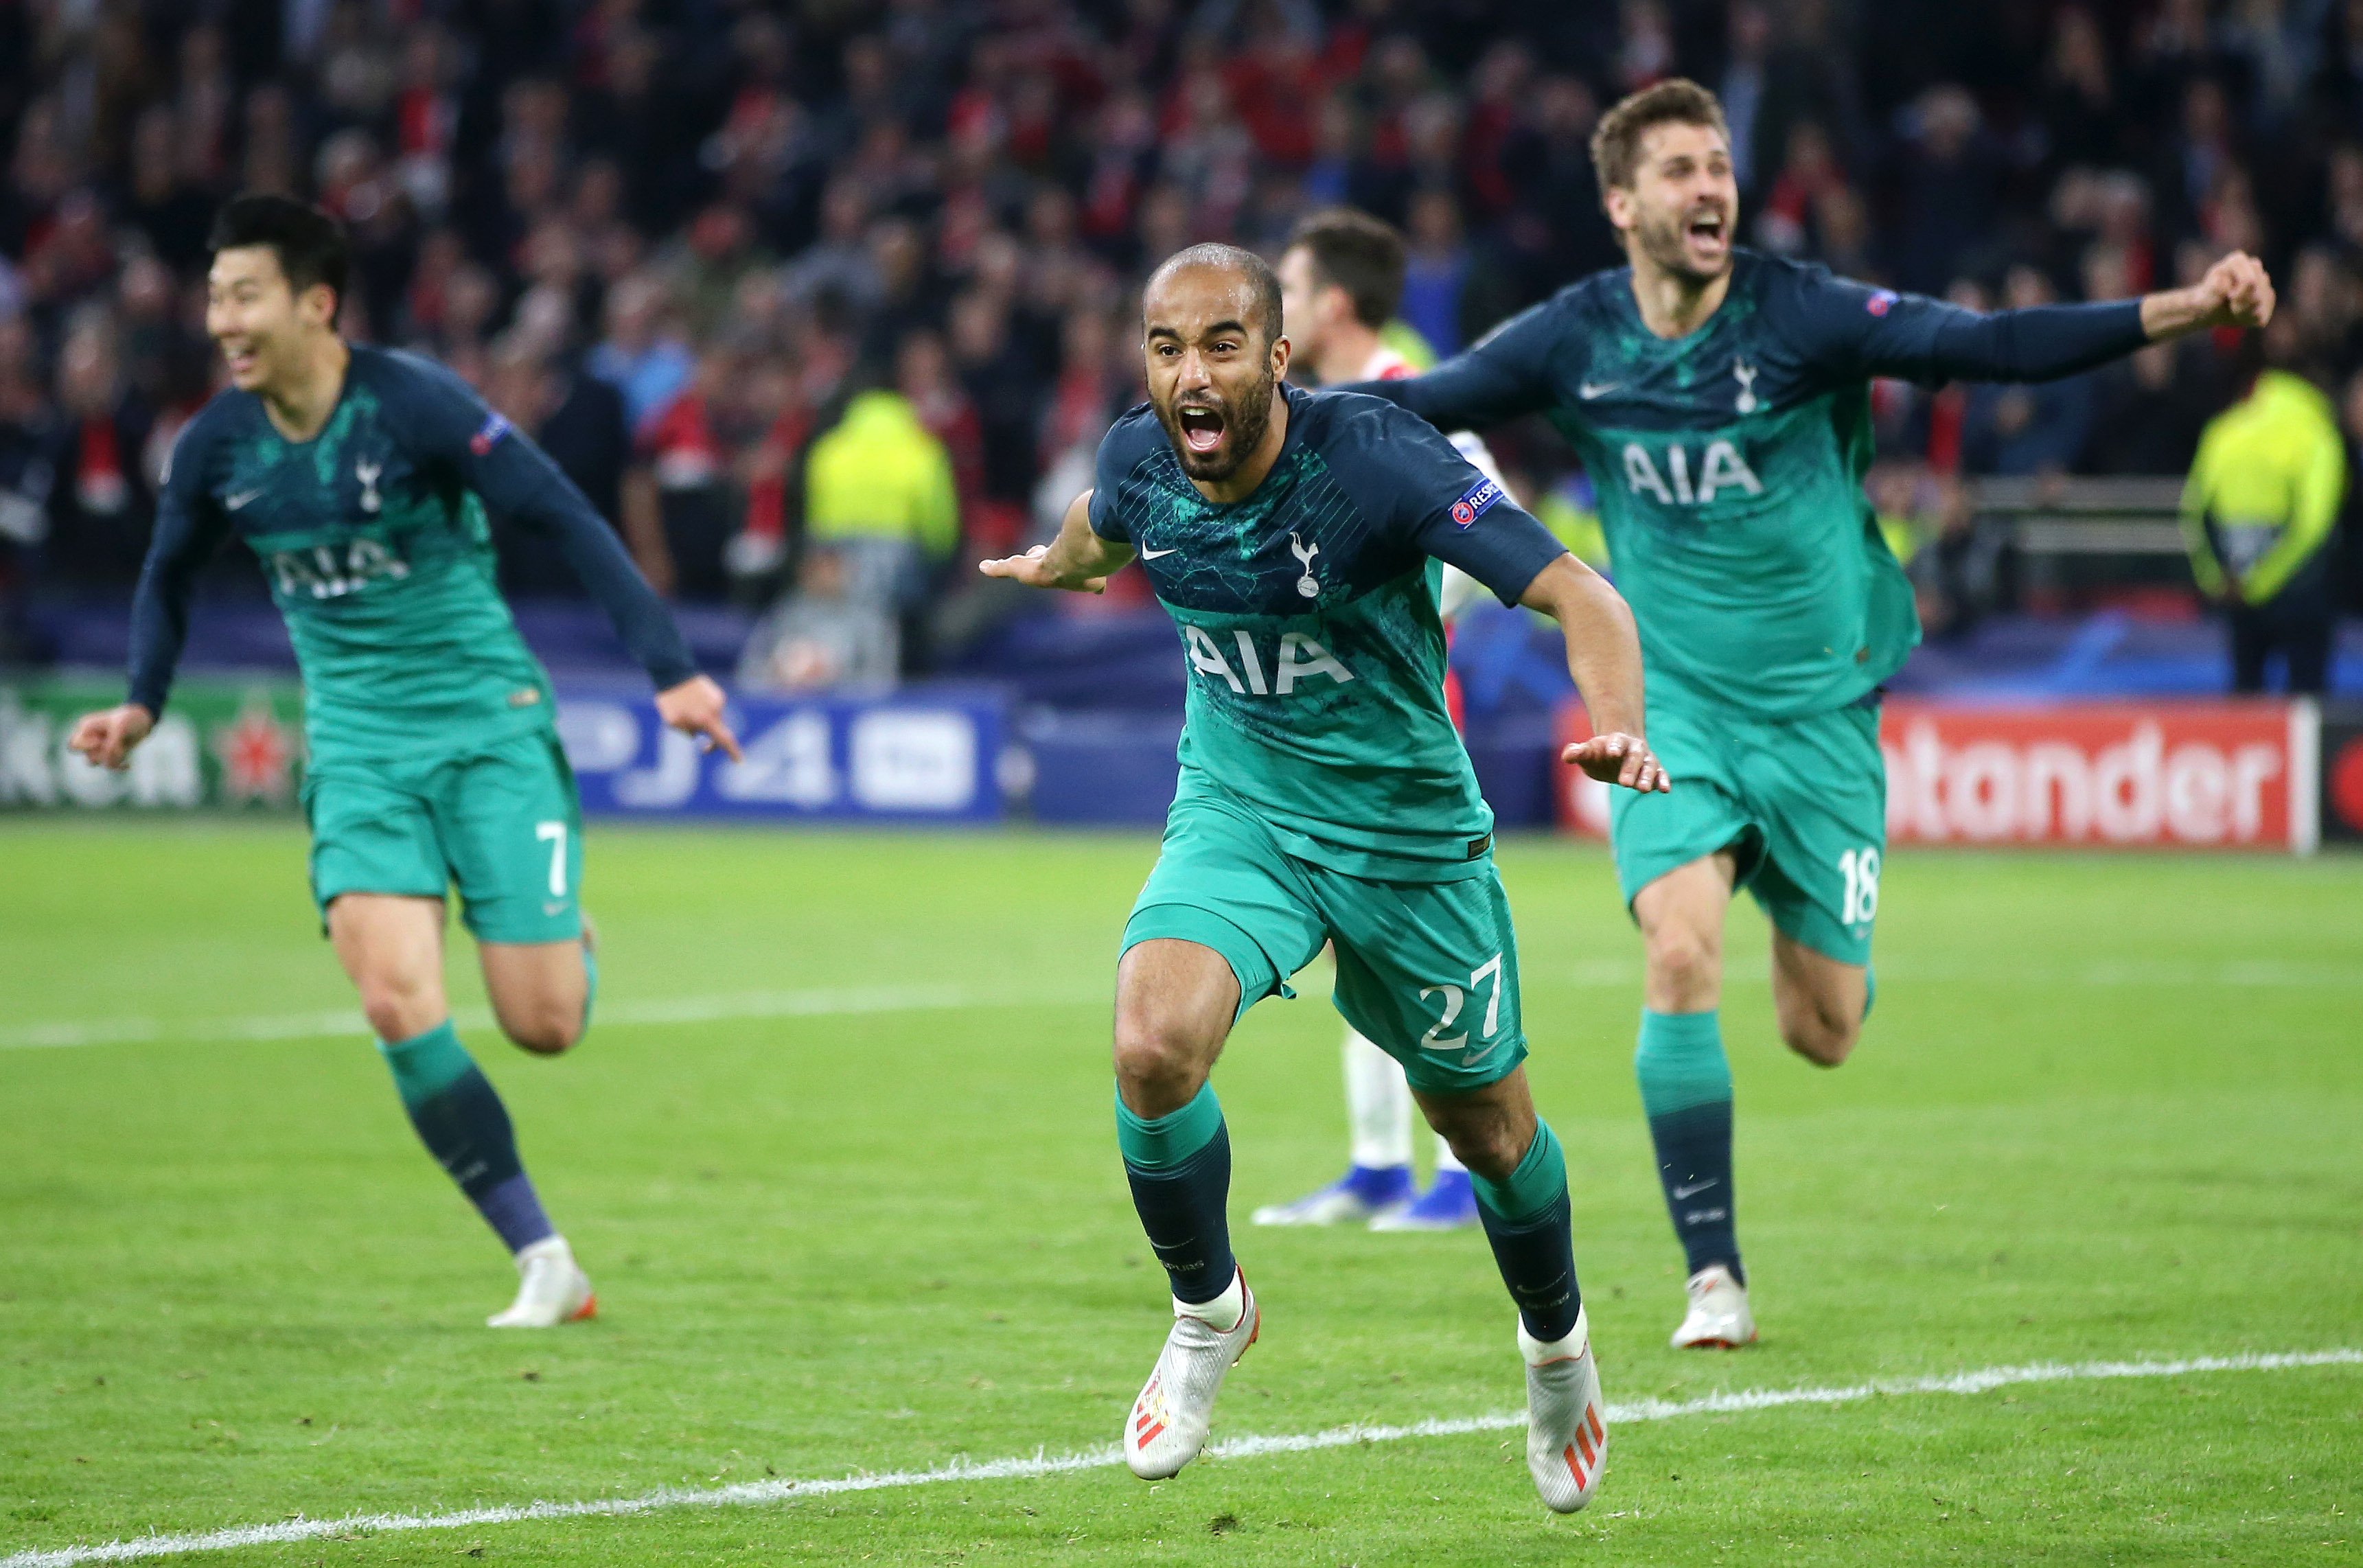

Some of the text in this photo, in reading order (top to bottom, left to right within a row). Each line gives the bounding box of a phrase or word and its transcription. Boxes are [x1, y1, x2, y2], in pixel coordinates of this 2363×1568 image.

[1623, 441, 1763, 505] AIA
[274, 538, 411, 599] AIA
[1186, 625, 1355, 695] AIA
[535, 820, 568, 897] 7
[1839, 845, 1880, 924] 18
[1419, 952, 1502, 1050] 27
